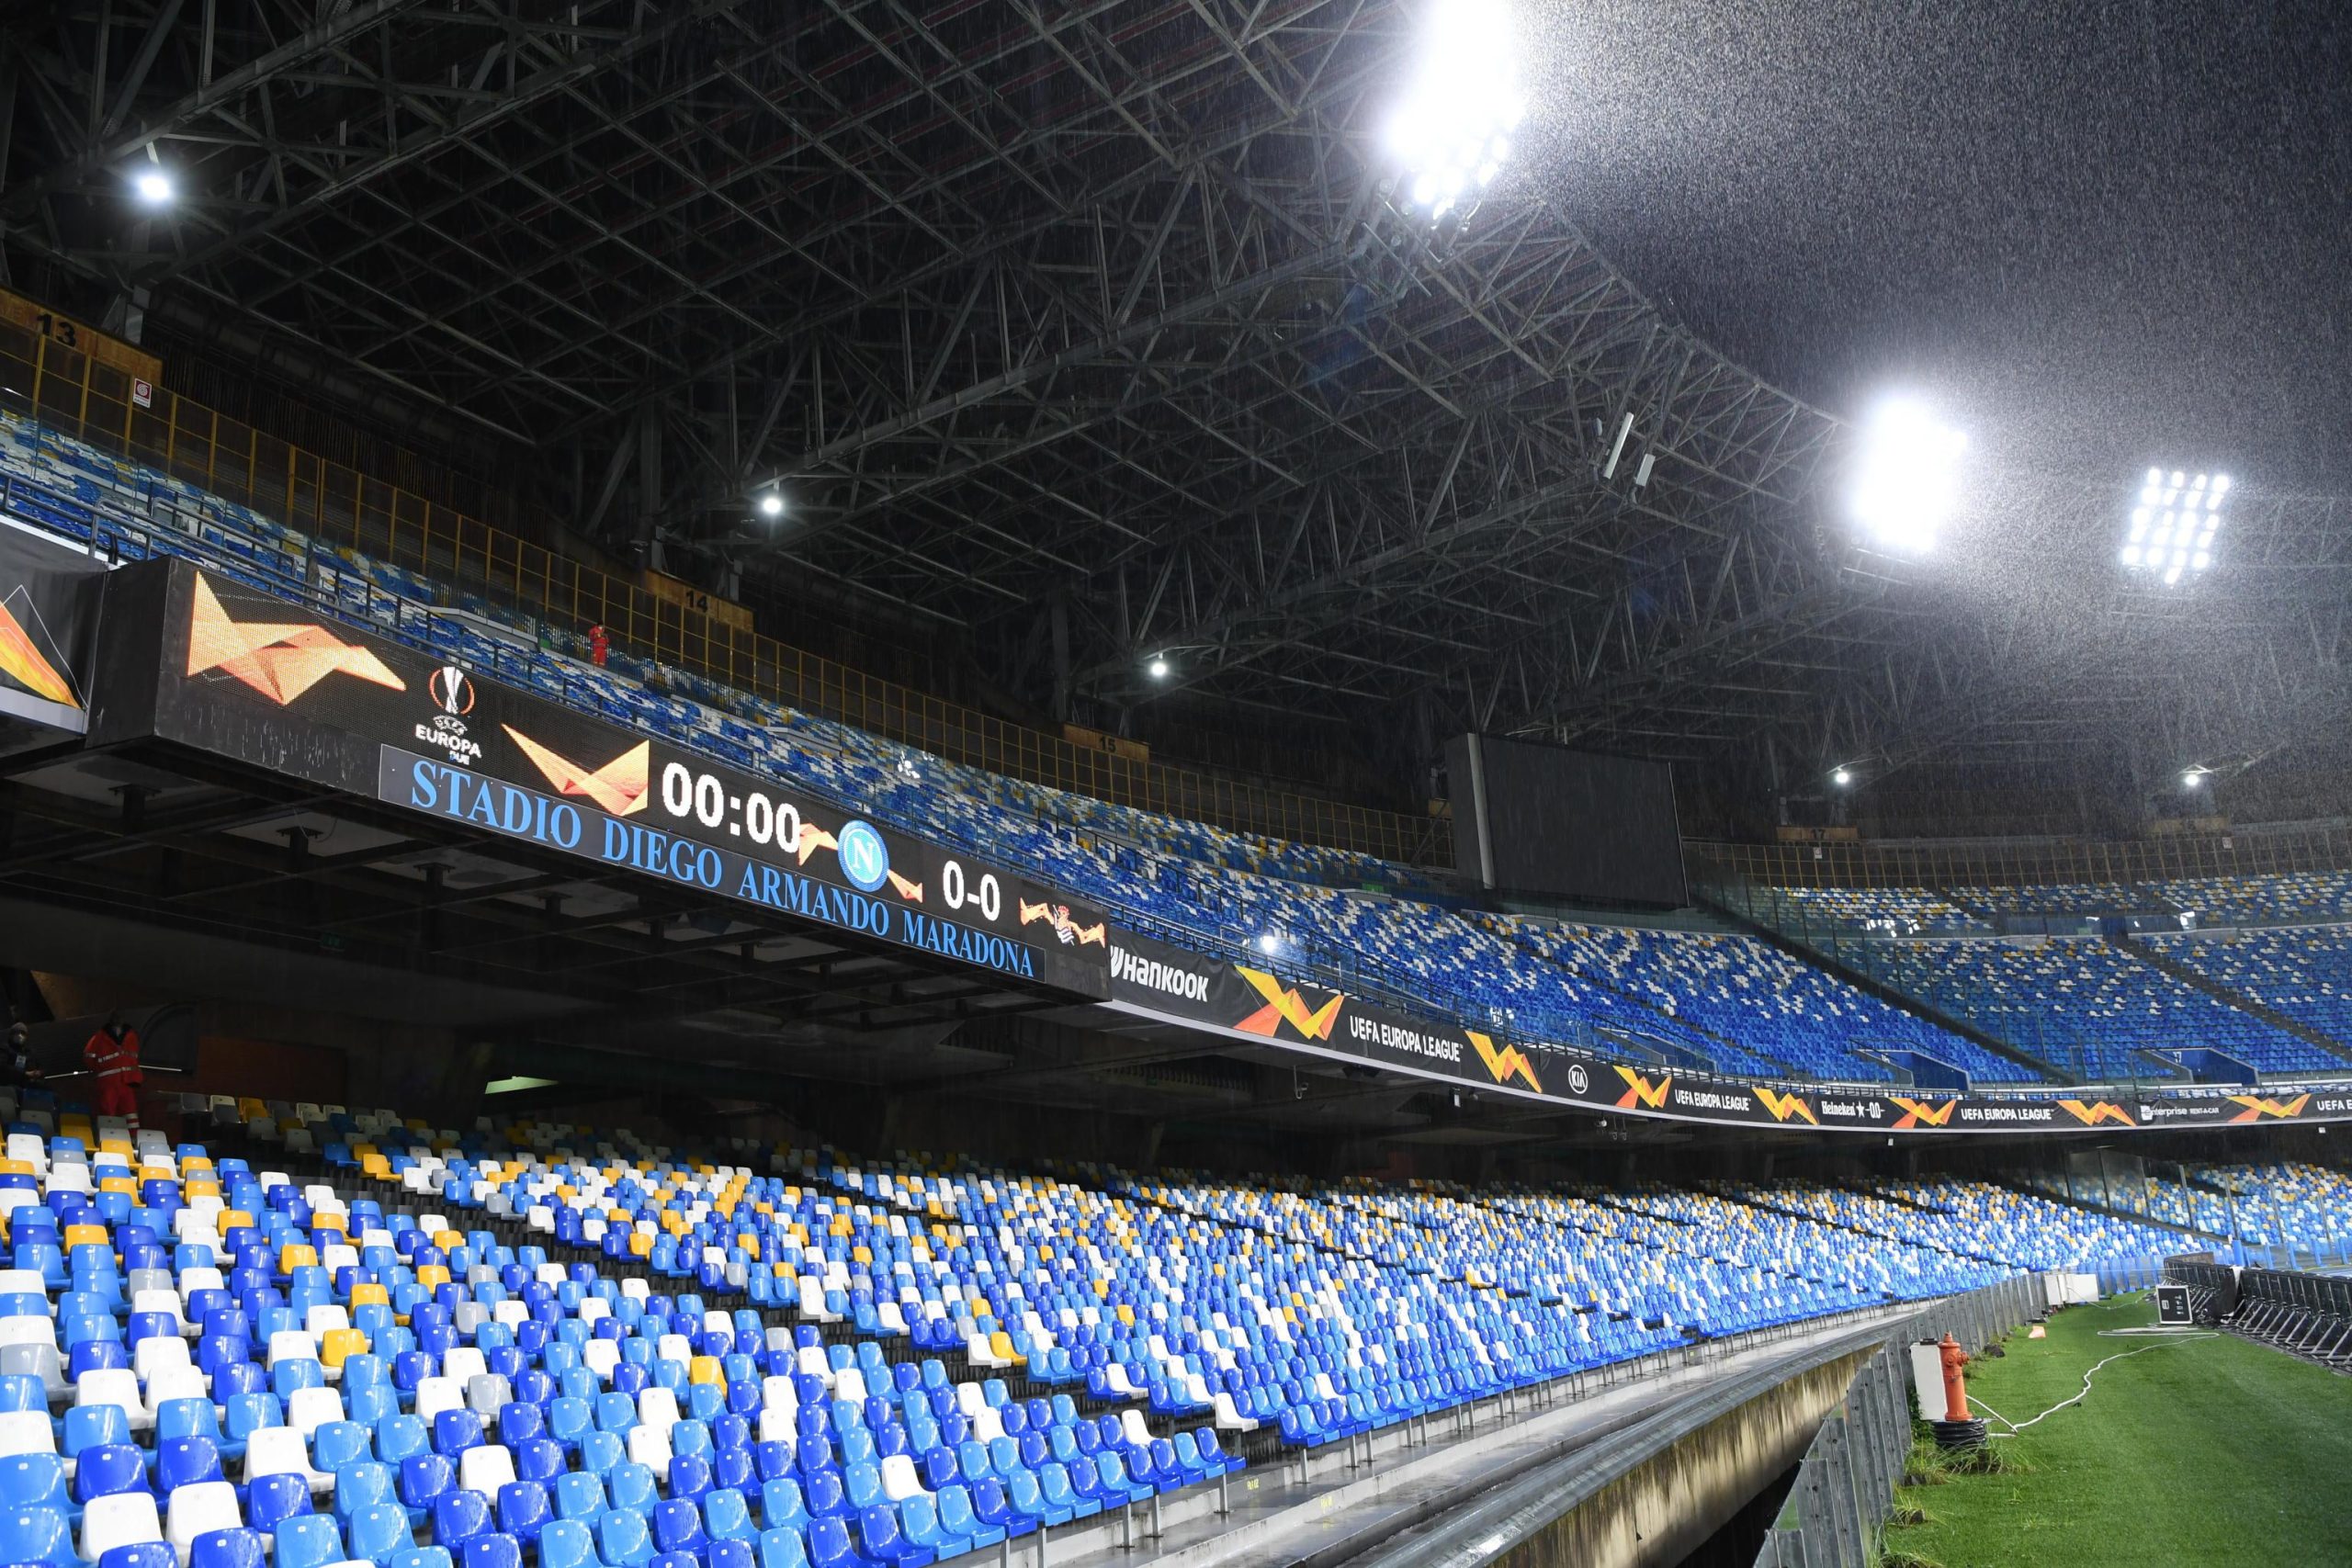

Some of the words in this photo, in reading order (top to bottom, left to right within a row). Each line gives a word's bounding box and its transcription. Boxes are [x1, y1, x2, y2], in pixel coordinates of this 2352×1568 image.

[38, 313, 76, 347] 13
[685, 590, 707, 613] 14
[415, 723, 482, 759] EUROPA
[1099, 736, 1116, 753] 15
[662, 761, 800, 852] 00:00
[412, 760, 582, 848] STADIO
[602, 817, 722, 888] DIEGO
[737, 862, 889, 936] ARMANDO
[901, 909, 1035, 977] MARADONA
[852, 837, 874, 873] N
[943, 860, 1001, 921] 0-0
[1350, 1015, 1380, 1043] UEFA
[1381, 1023, 1422, 1054] EUROPA
[1571, 1070, 1586, 1089] KIA
[1674, 1089, 1693, 1106] UEFA
[1695, 1092, 1721, 1109] EUROPA
[1821, 1100, 1855, 1117] Heineken
[2317, 1100, 2345, 1111] UEFA
[1961, 1108, 1983, 1120] UEFA
[1984, 1108, 2018, 1121] EUROPA
